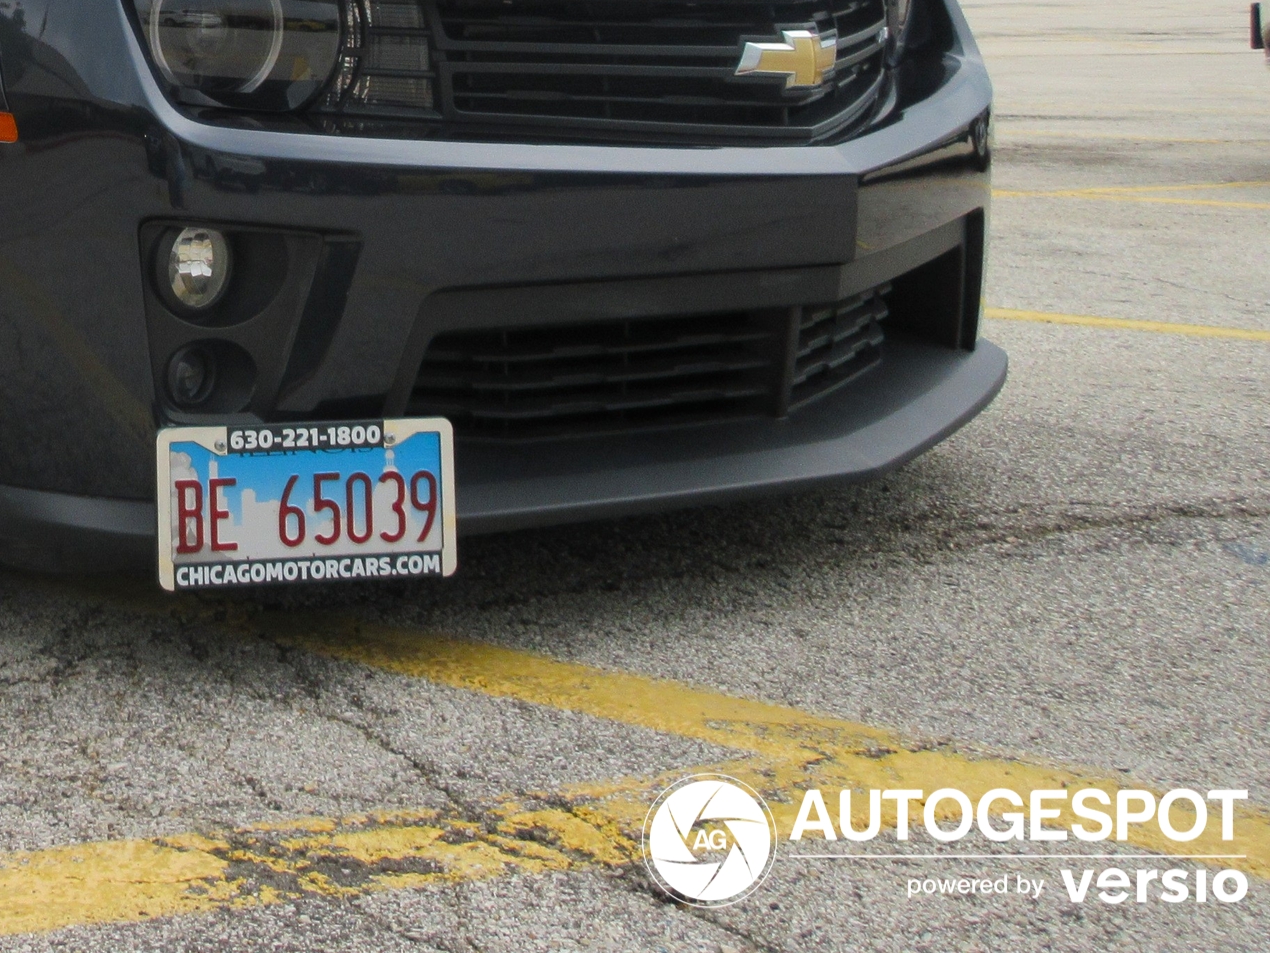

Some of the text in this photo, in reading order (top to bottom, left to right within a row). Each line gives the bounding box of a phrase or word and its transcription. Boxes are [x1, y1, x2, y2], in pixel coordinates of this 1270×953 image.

[230, 425, 381, 449] 630-221-1800
[175, 470, 437, 554] BE 65039
[176, 554, 441, 586] CHICAGOMOTORCARS.COM
